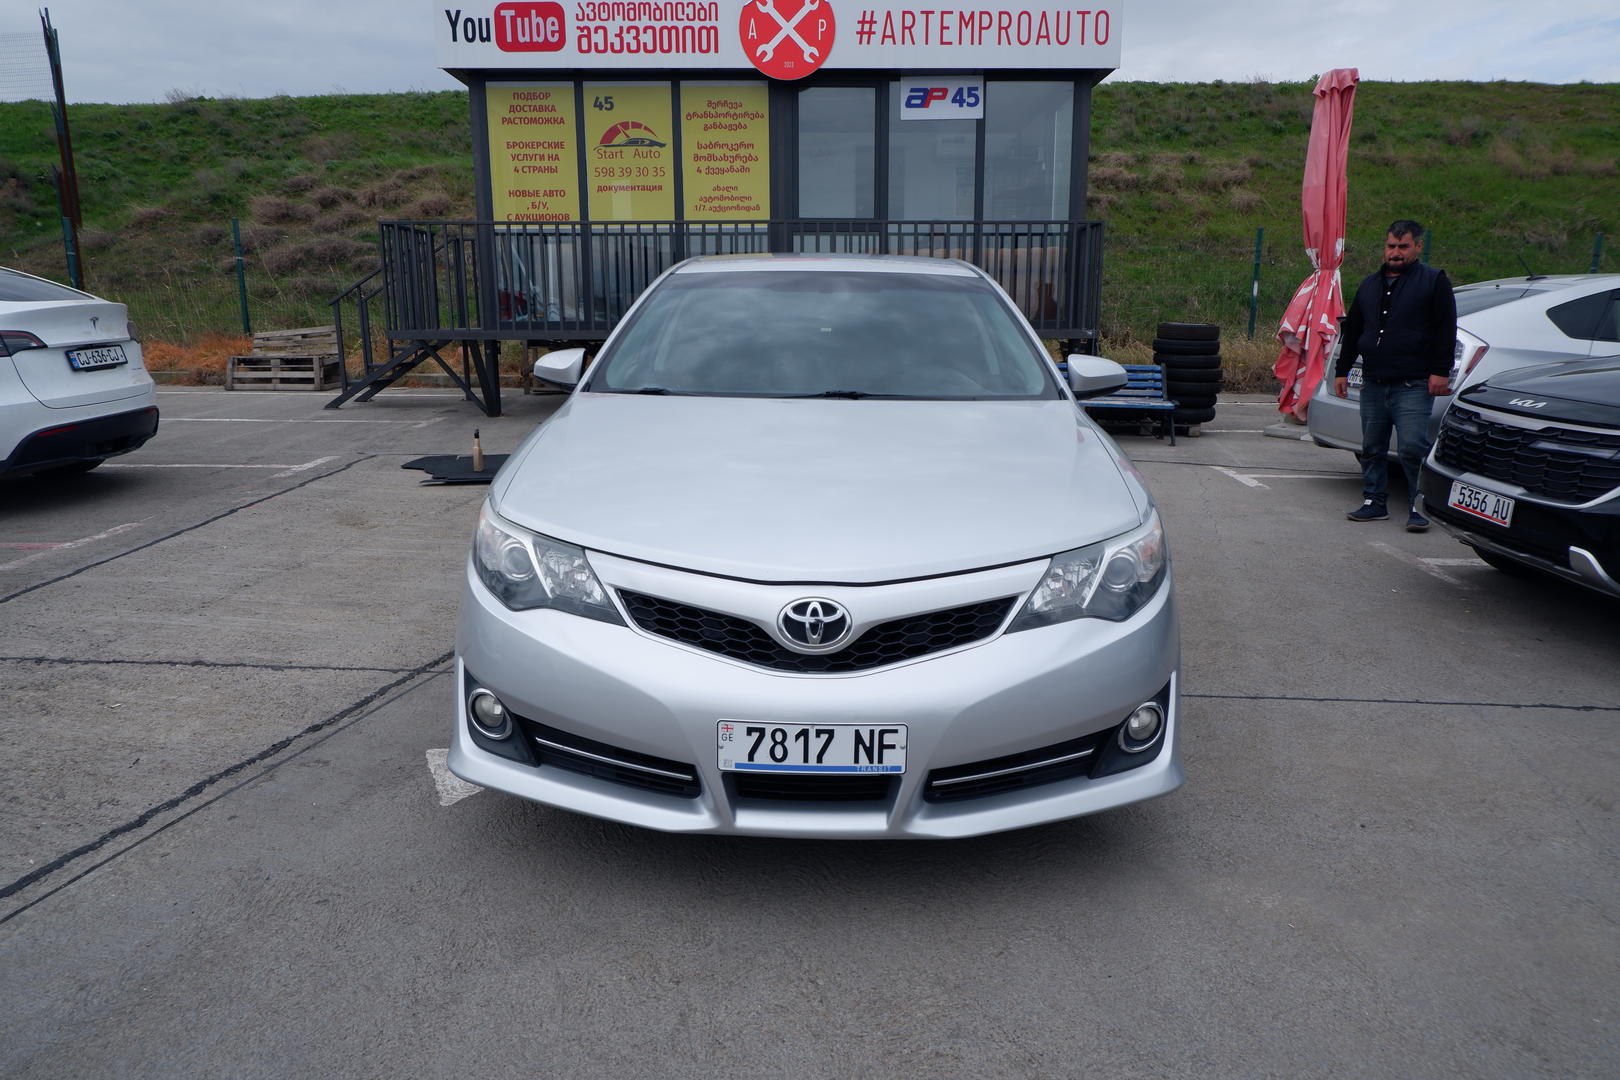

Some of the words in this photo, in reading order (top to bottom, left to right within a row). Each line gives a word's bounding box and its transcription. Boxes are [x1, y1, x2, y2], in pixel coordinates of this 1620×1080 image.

[575, 2, 719, 22] ავტომობილები
[748, 18, 757, 40] A
[818, 19, 827, 41] P
[856, 10, 1110, 46] #ARTEMPROAUTO
[576, 25, 719, 54] შეკვეთით
[512, 92, 551, 101] ПОДБОР
[951, 86, 980, 108] 45
[593, 96, 615, 111] 45
[508, 104, 557, 114] ДОСТАВКА
[501, 117, 566, 125] РАСТОМОЖКА
[506, 141, 566, 150] БРОКЕРСКИЕ
[511, 153, 545, 162] УСЛУГИ
[548, 153, 561, 162] НА
[597, 148, 624, 159] Start
[633, 148, 661, 159] Auto
[514, 166, 519, 174] 4
[521, 165, 558, 174] СТРАНЫ
[594, 167, 615, 178] 598
[618, 167, 632, 178] 39
[635, 167, 649, 178] 30
[652, 167, 666, 178] 35
[697, 166, 702, 174] 4
[508, 189, 540, 198] НОВЫЕ
[542, 189, 566, 198] АВТО
[596, 184, 663, 193] документация
[515, 213, 570, 221] АУКЦИОНОВ
[76, 348, 120, 366] CJ-636-CJ
[1457, 486, 1489, 513] 5356
[1491, 498, 1511, 521] AU
[721, 733, 734, 742] GE
[746, 726, 835, 764] 7817
[853, 728, 899, 765] NF
